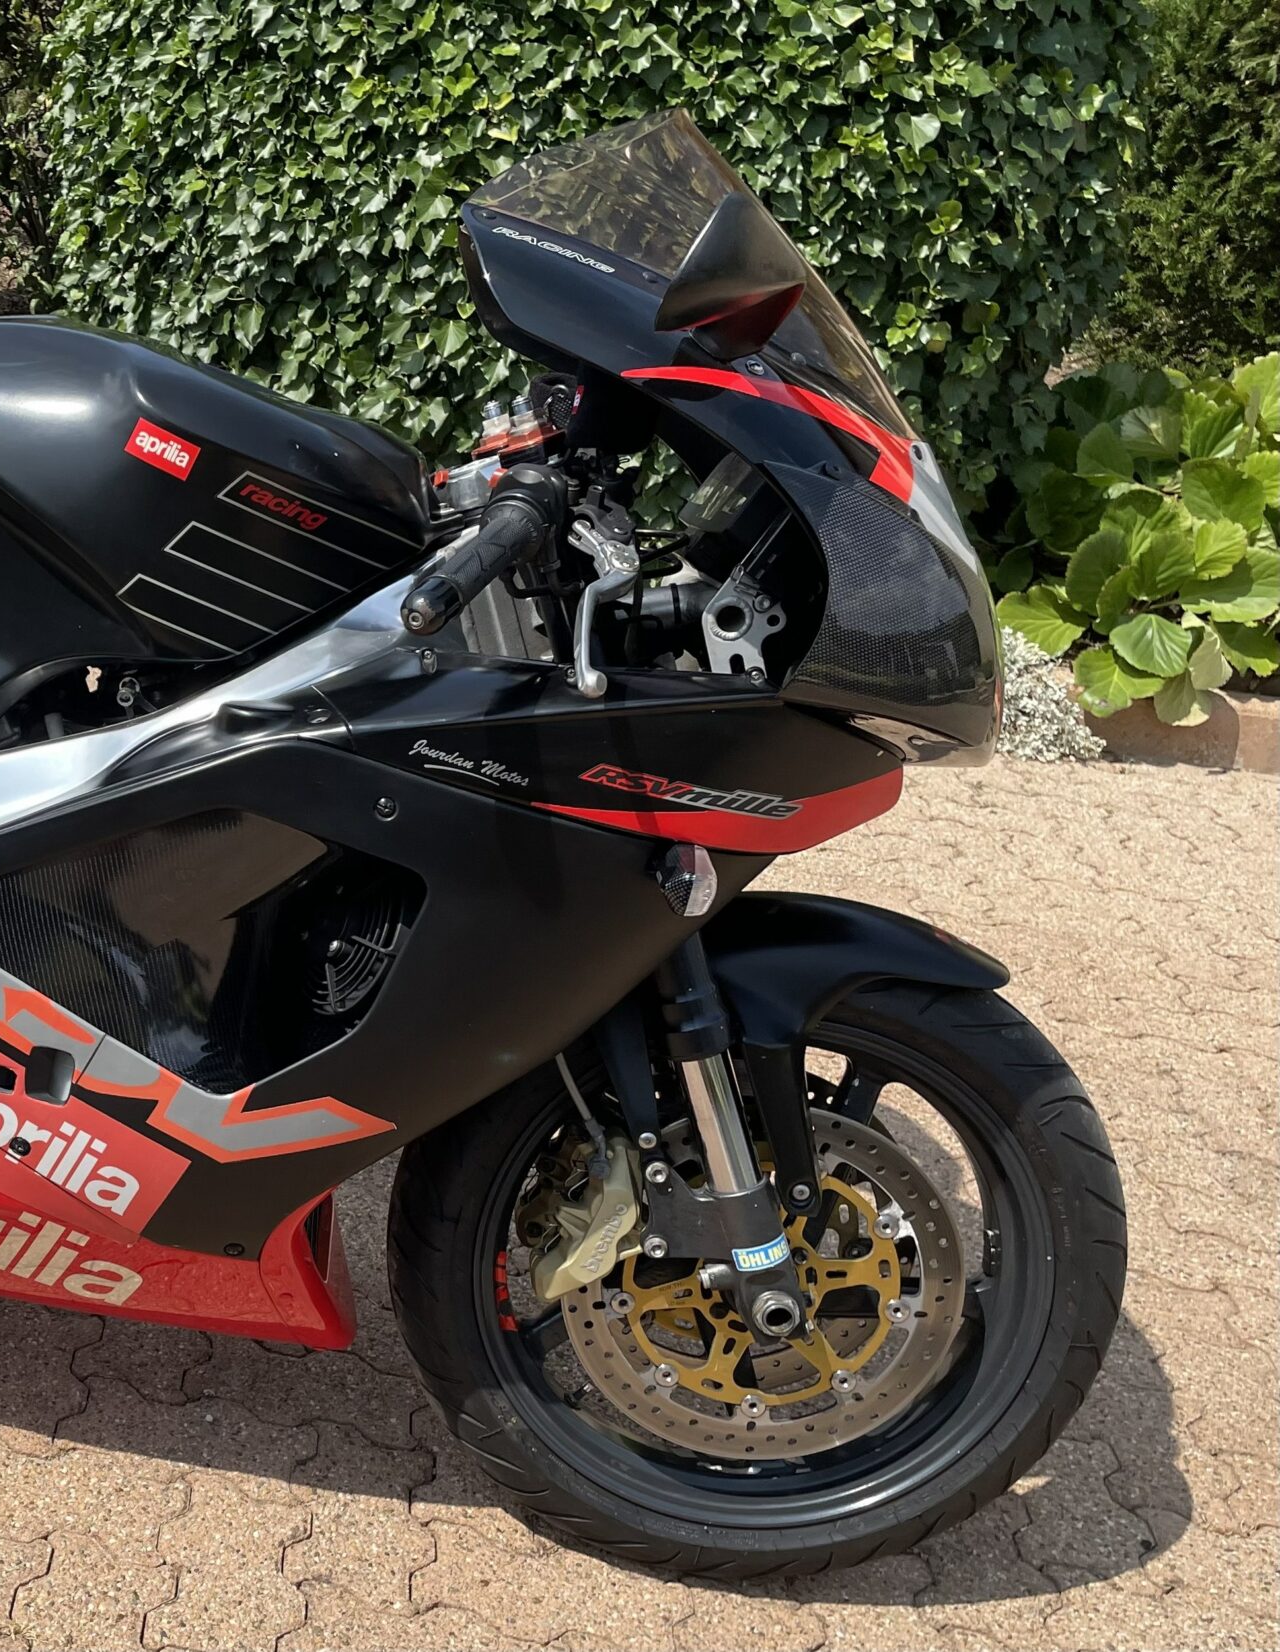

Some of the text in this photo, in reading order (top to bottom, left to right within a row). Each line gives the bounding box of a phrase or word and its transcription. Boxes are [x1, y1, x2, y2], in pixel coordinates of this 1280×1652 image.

[492, 226, 616, 274] RACING
[135, 431, 190, 468] aprilia
[239, 482, 328, 531] racing
[408, 739, 529, 786] Jourdan Motos
[580, 1203, 627, 1274] brembo
[738, 1240, 788, 1269] ÖHLINS
